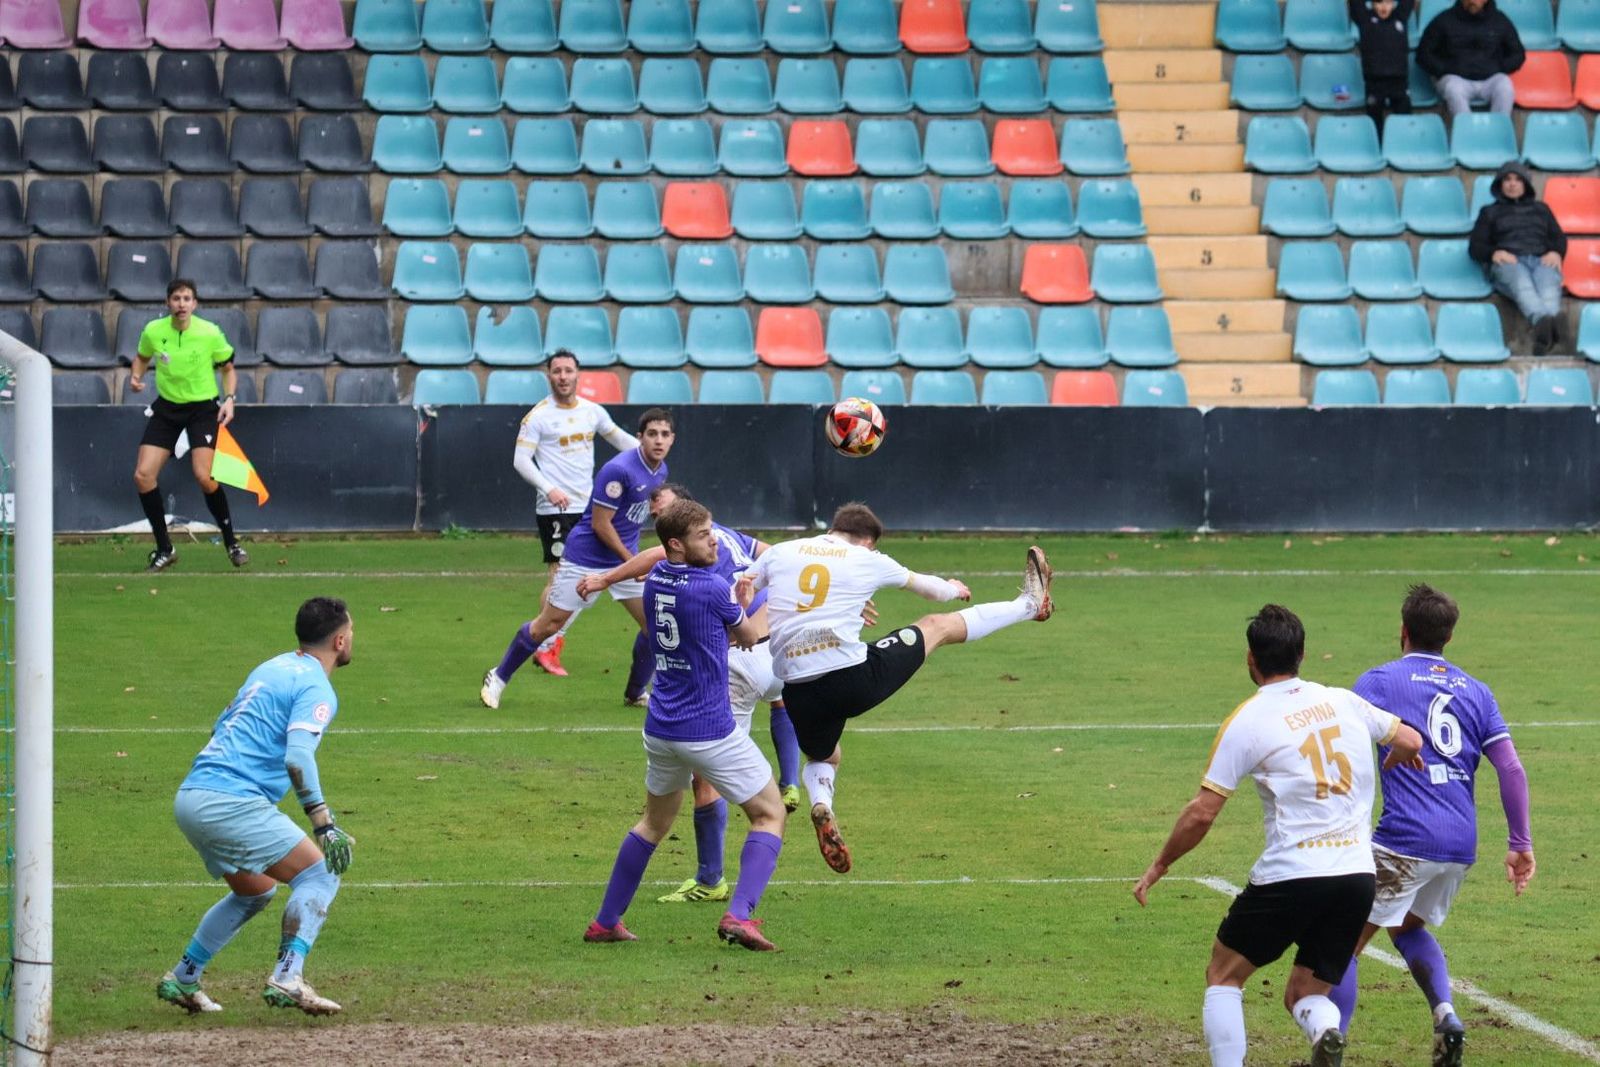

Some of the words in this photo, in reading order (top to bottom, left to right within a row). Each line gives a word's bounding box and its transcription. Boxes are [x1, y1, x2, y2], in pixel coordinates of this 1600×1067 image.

[1155, 63, 1166, 79] 8
[1175, 124, 1186, 141] 7
[1190, 188, 1202, 203] 6
[1217, 313, 1230, 330] 4
[552, 520, 562, 539] 2
[795, 563, 831, 613] 9
[654, 593, 680, 651] 5
[1284, 702, 1337, 732] ESPINA
[1427, 692, 1463, 758] 6
[1298, 724, 1353, 800] 15
